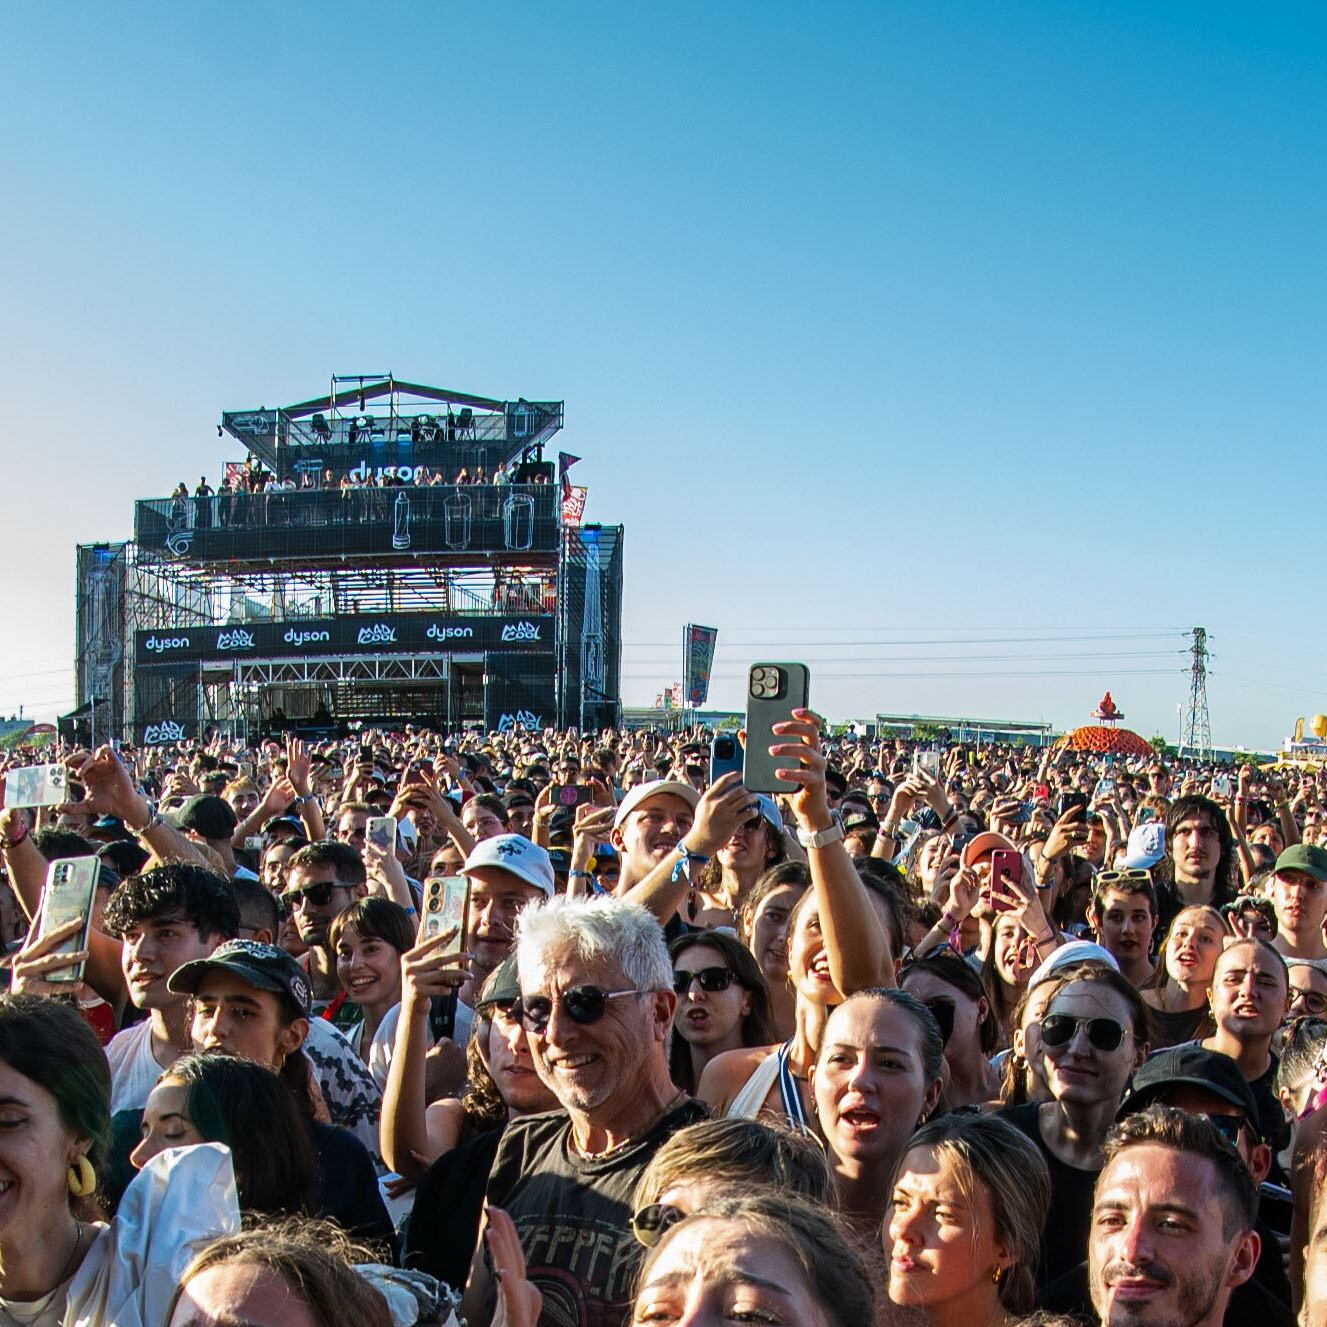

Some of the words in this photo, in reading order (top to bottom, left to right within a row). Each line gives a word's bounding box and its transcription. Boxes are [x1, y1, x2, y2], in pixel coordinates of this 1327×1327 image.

[218, 633, 256, 650] COOL
[284, 628, 330, 646] dyson
[358, 628, 398, 645] COOL
[426, 624, 473, 642] dyson
[502, 625, 541, 641] COOL
[145, 635, 190, 653] dyson
[144, 725, 187, 744] COOL
